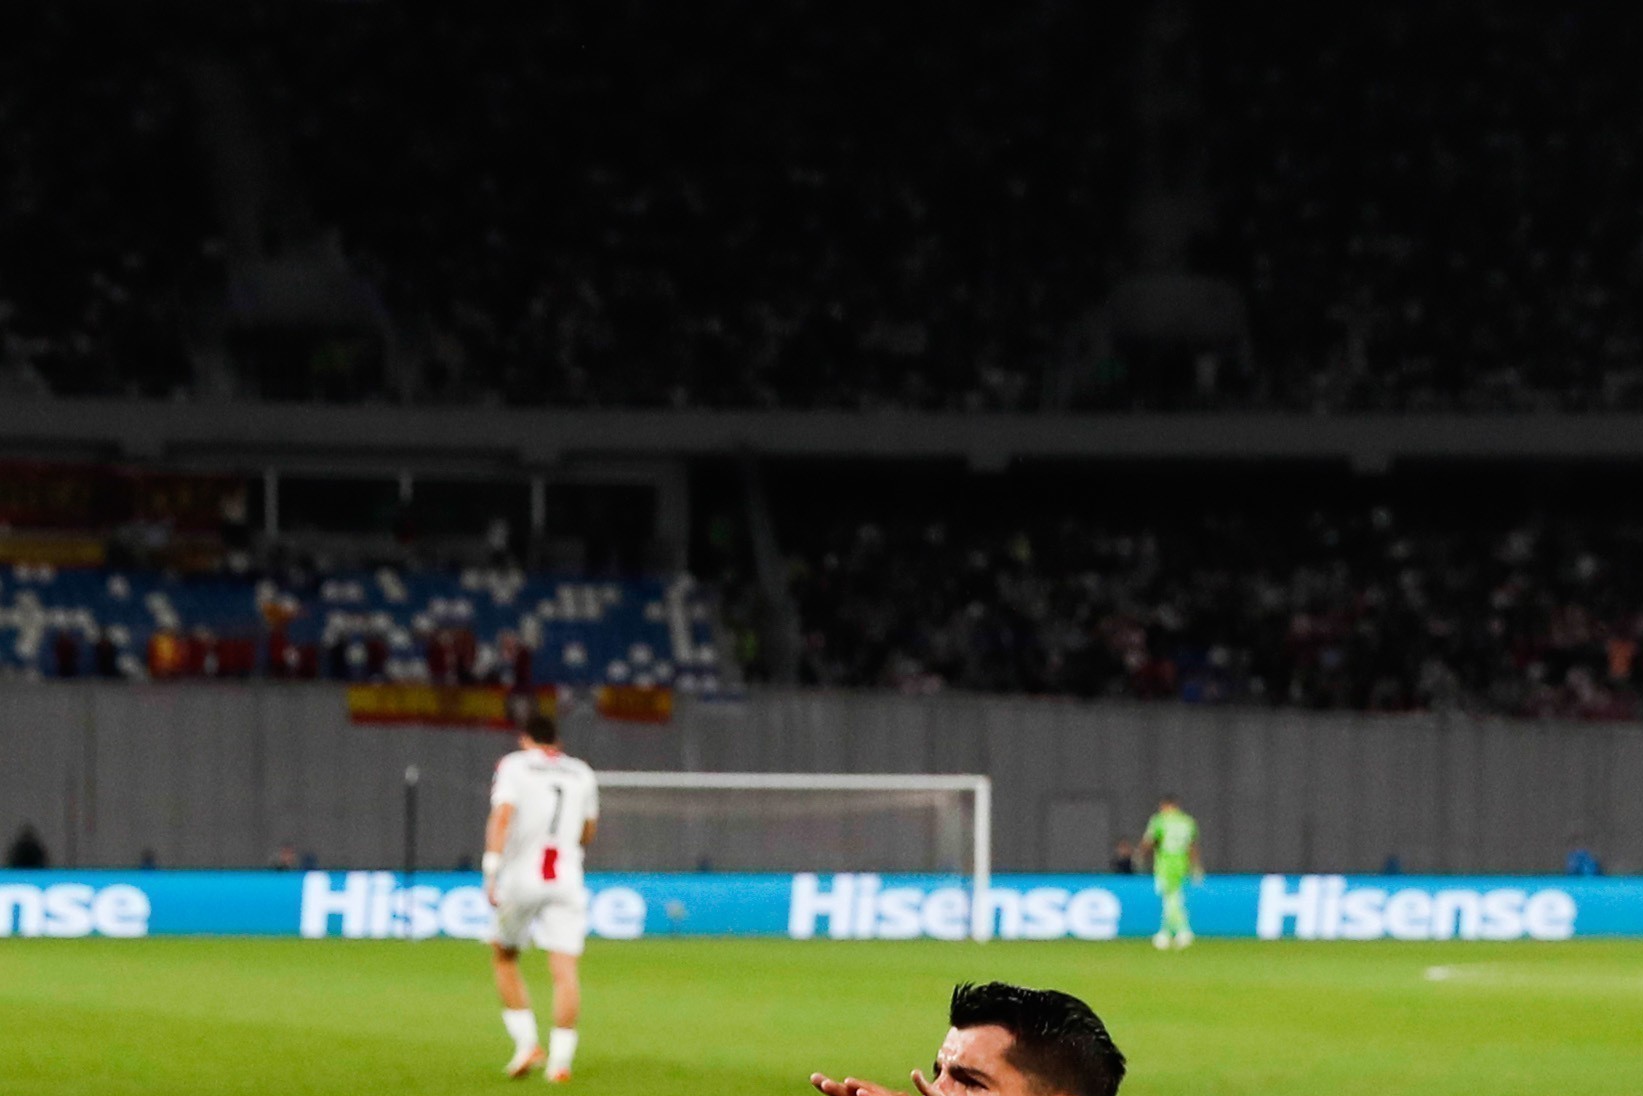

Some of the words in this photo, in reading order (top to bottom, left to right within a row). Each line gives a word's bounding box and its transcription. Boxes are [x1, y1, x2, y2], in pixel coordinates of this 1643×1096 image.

[0, 883, 152, 938] nse
[301, 871, 647, 940] Hisee
[788, 872, 1121, 940] Hisense
[1256, 874, 1577, 940] Hisense
